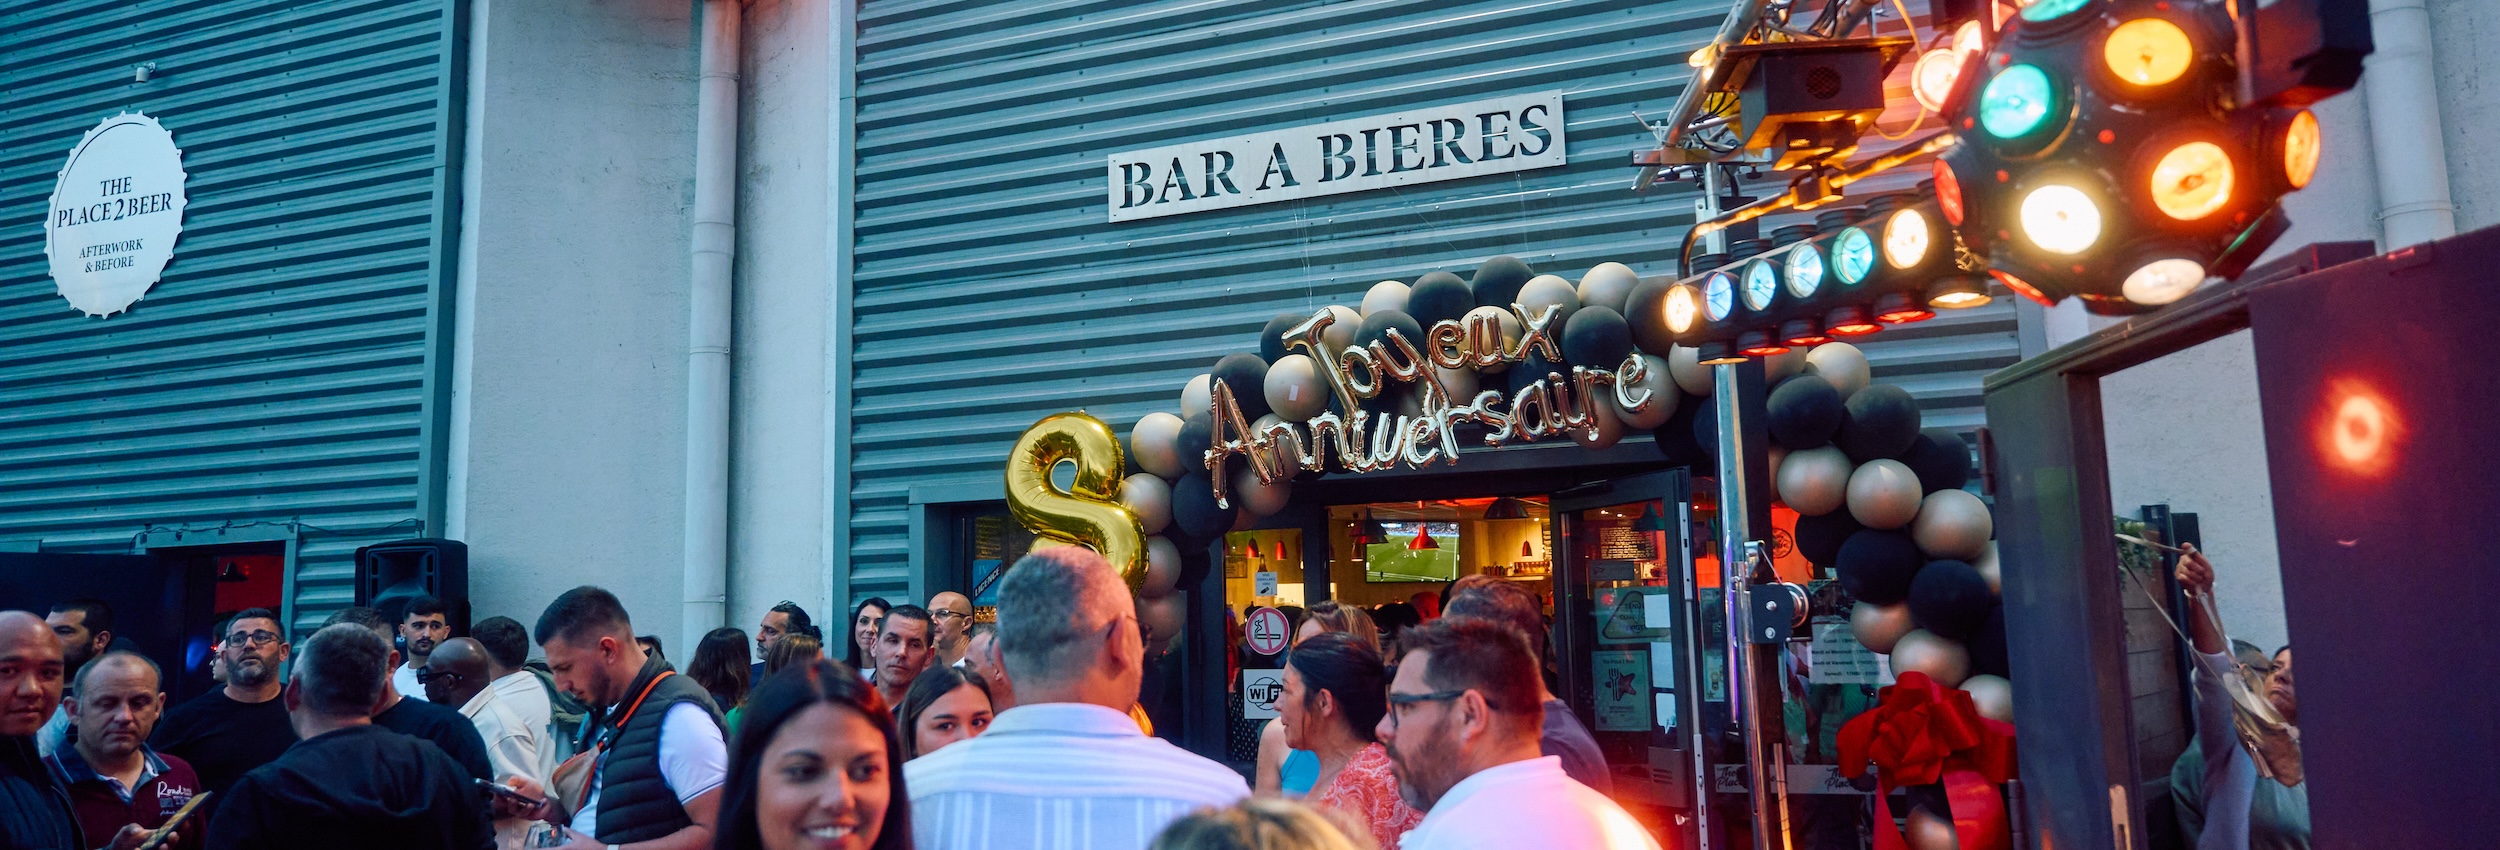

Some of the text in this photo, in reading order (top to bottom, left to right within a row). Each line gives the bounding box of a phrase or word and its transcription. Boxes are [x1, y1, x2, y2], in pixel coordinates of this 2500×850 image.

[1118, 104, 1553, 210] BAR A BIERES
[100, 176, 132, 197] THE
[57, 202, 112, 229] PLACE
[127, 192, 172, 217] BEER
[79, 238, 144, 259] AFTERWORK
[84, 255, 135, 273] & BEFORE
[1204, 352, 1654, 510] Anniversaire
[974, 566, 1001, 598] LICENCE
